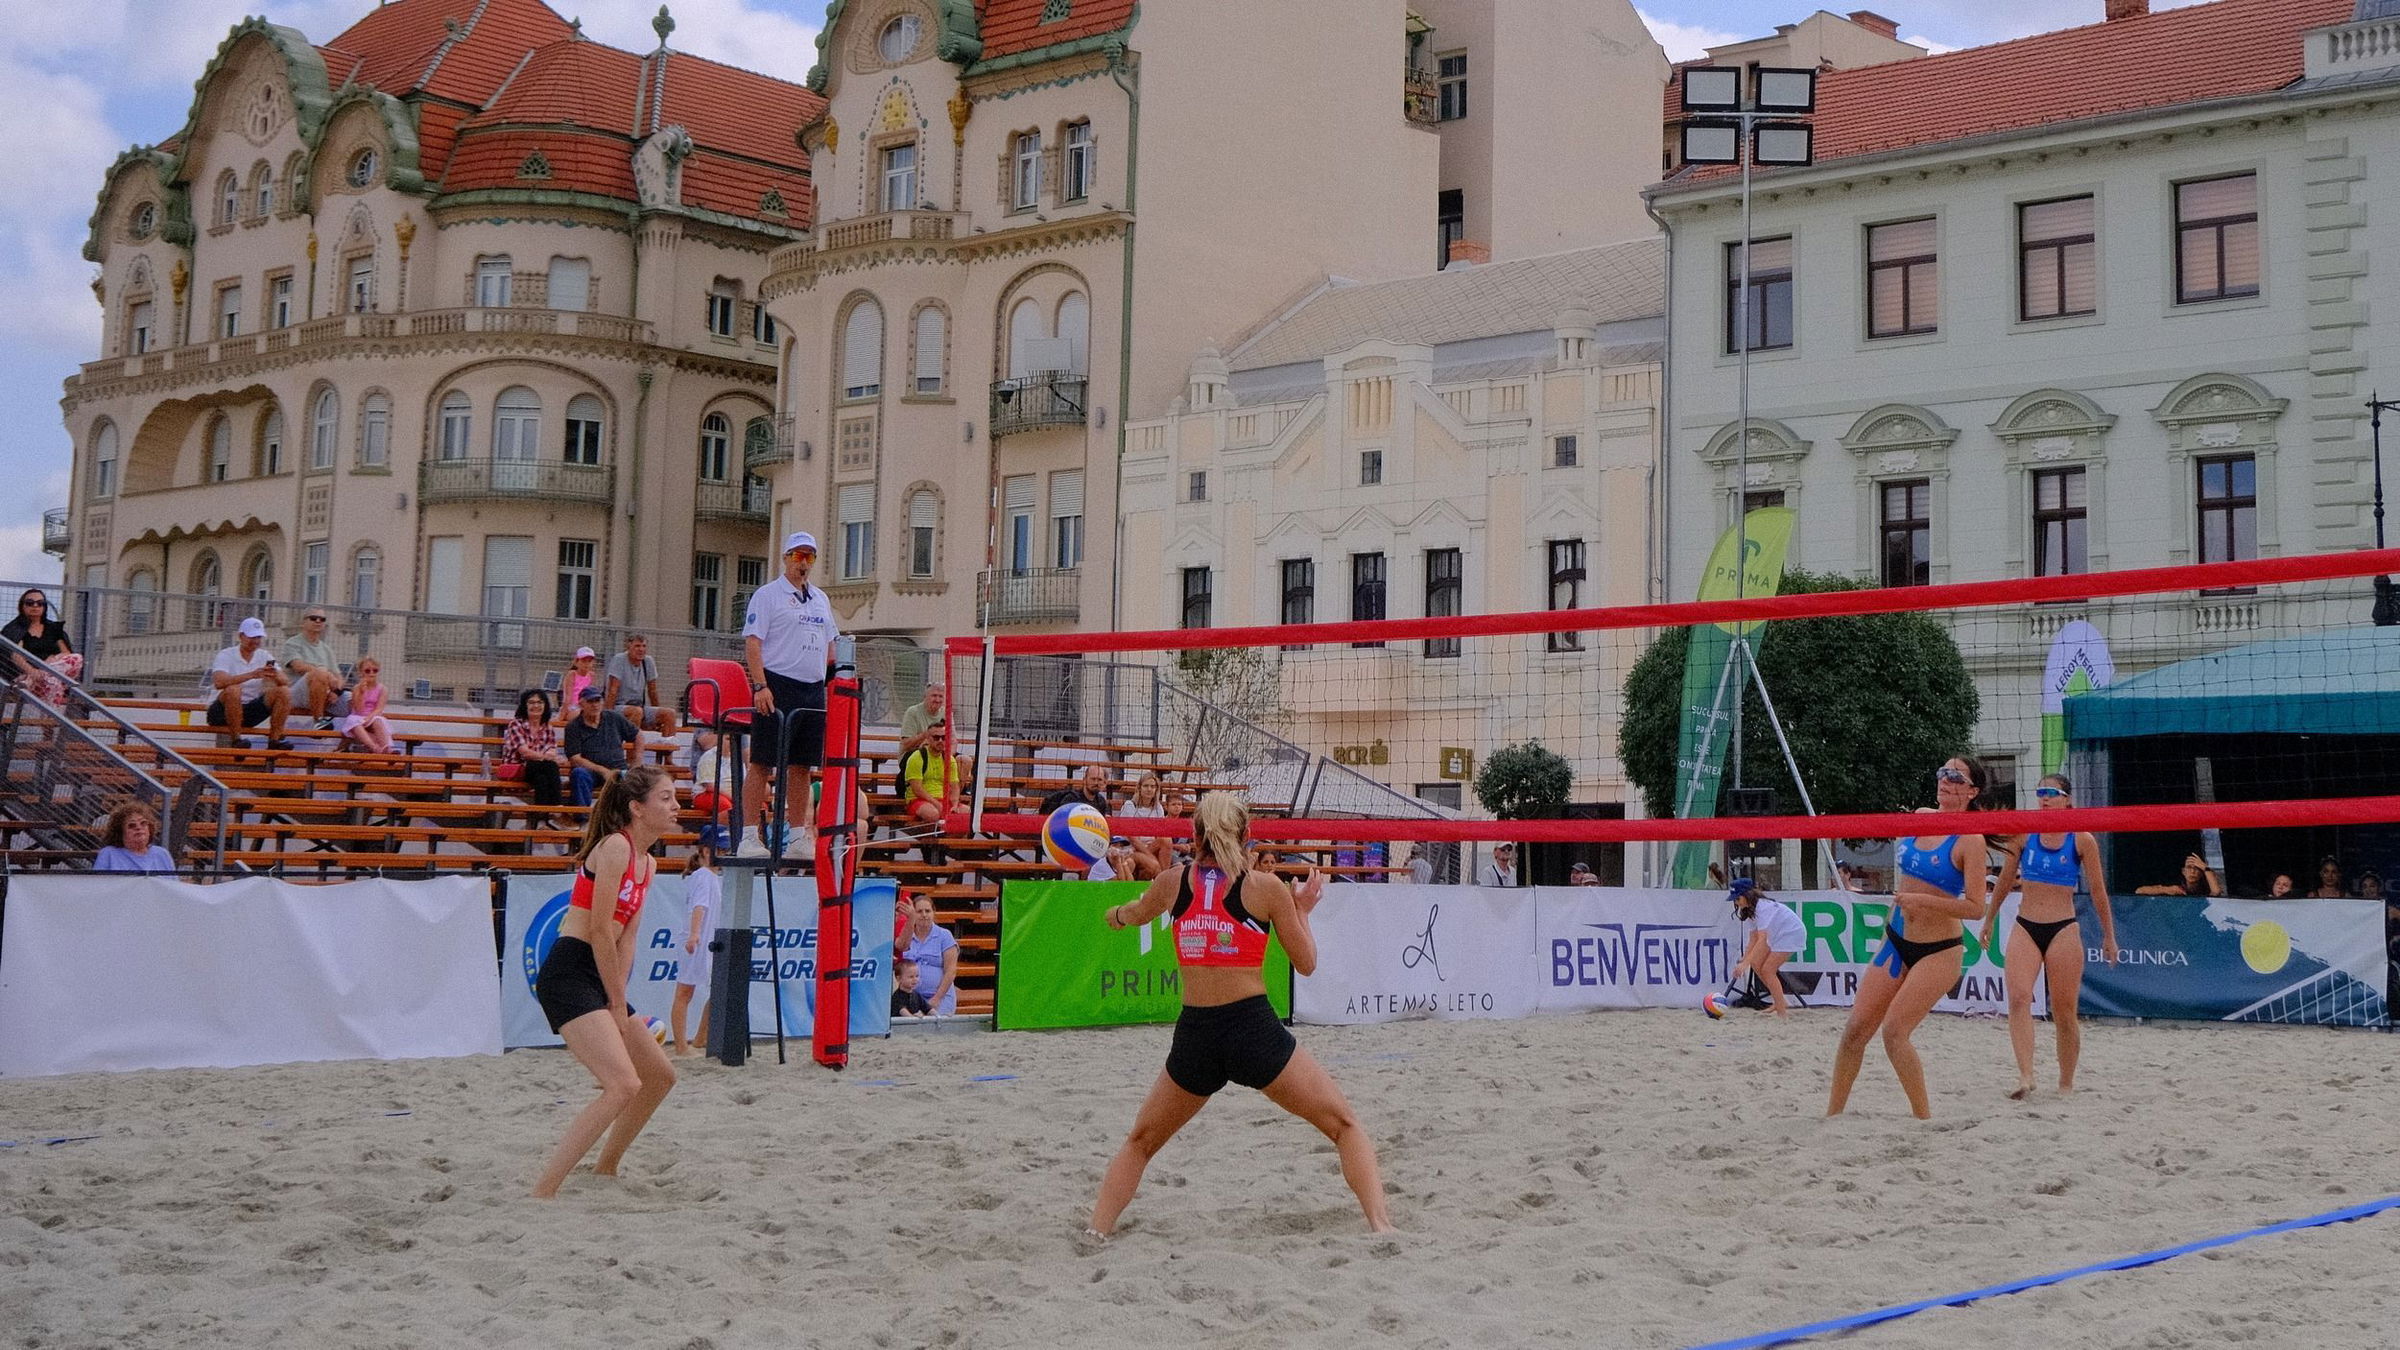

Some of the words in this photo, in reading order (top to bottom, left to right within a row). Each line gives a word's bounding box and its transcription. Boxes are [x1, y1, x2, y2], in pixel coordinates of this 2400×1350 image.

[1715, 566, 1770, 589] PRMA
[2055, 654, 2079, 692] LEROY
[1691, 705, 1729, 720] SUCCSUL
[619, 880, 634, 901] 2
[1204, 879, 1215, 910] 1
[1180, 919, 1235, 934] MINUNILOR
[1552, 923, 1730, 987] BENVENUTI
[2087, 948, 2189, 967] BICLINICA
[1101, 969, 1178, 1000] PRIM
[1346, 993, 1438, 1015] ARTEMIS
[1448, 992, 1494, 1012] LETO
